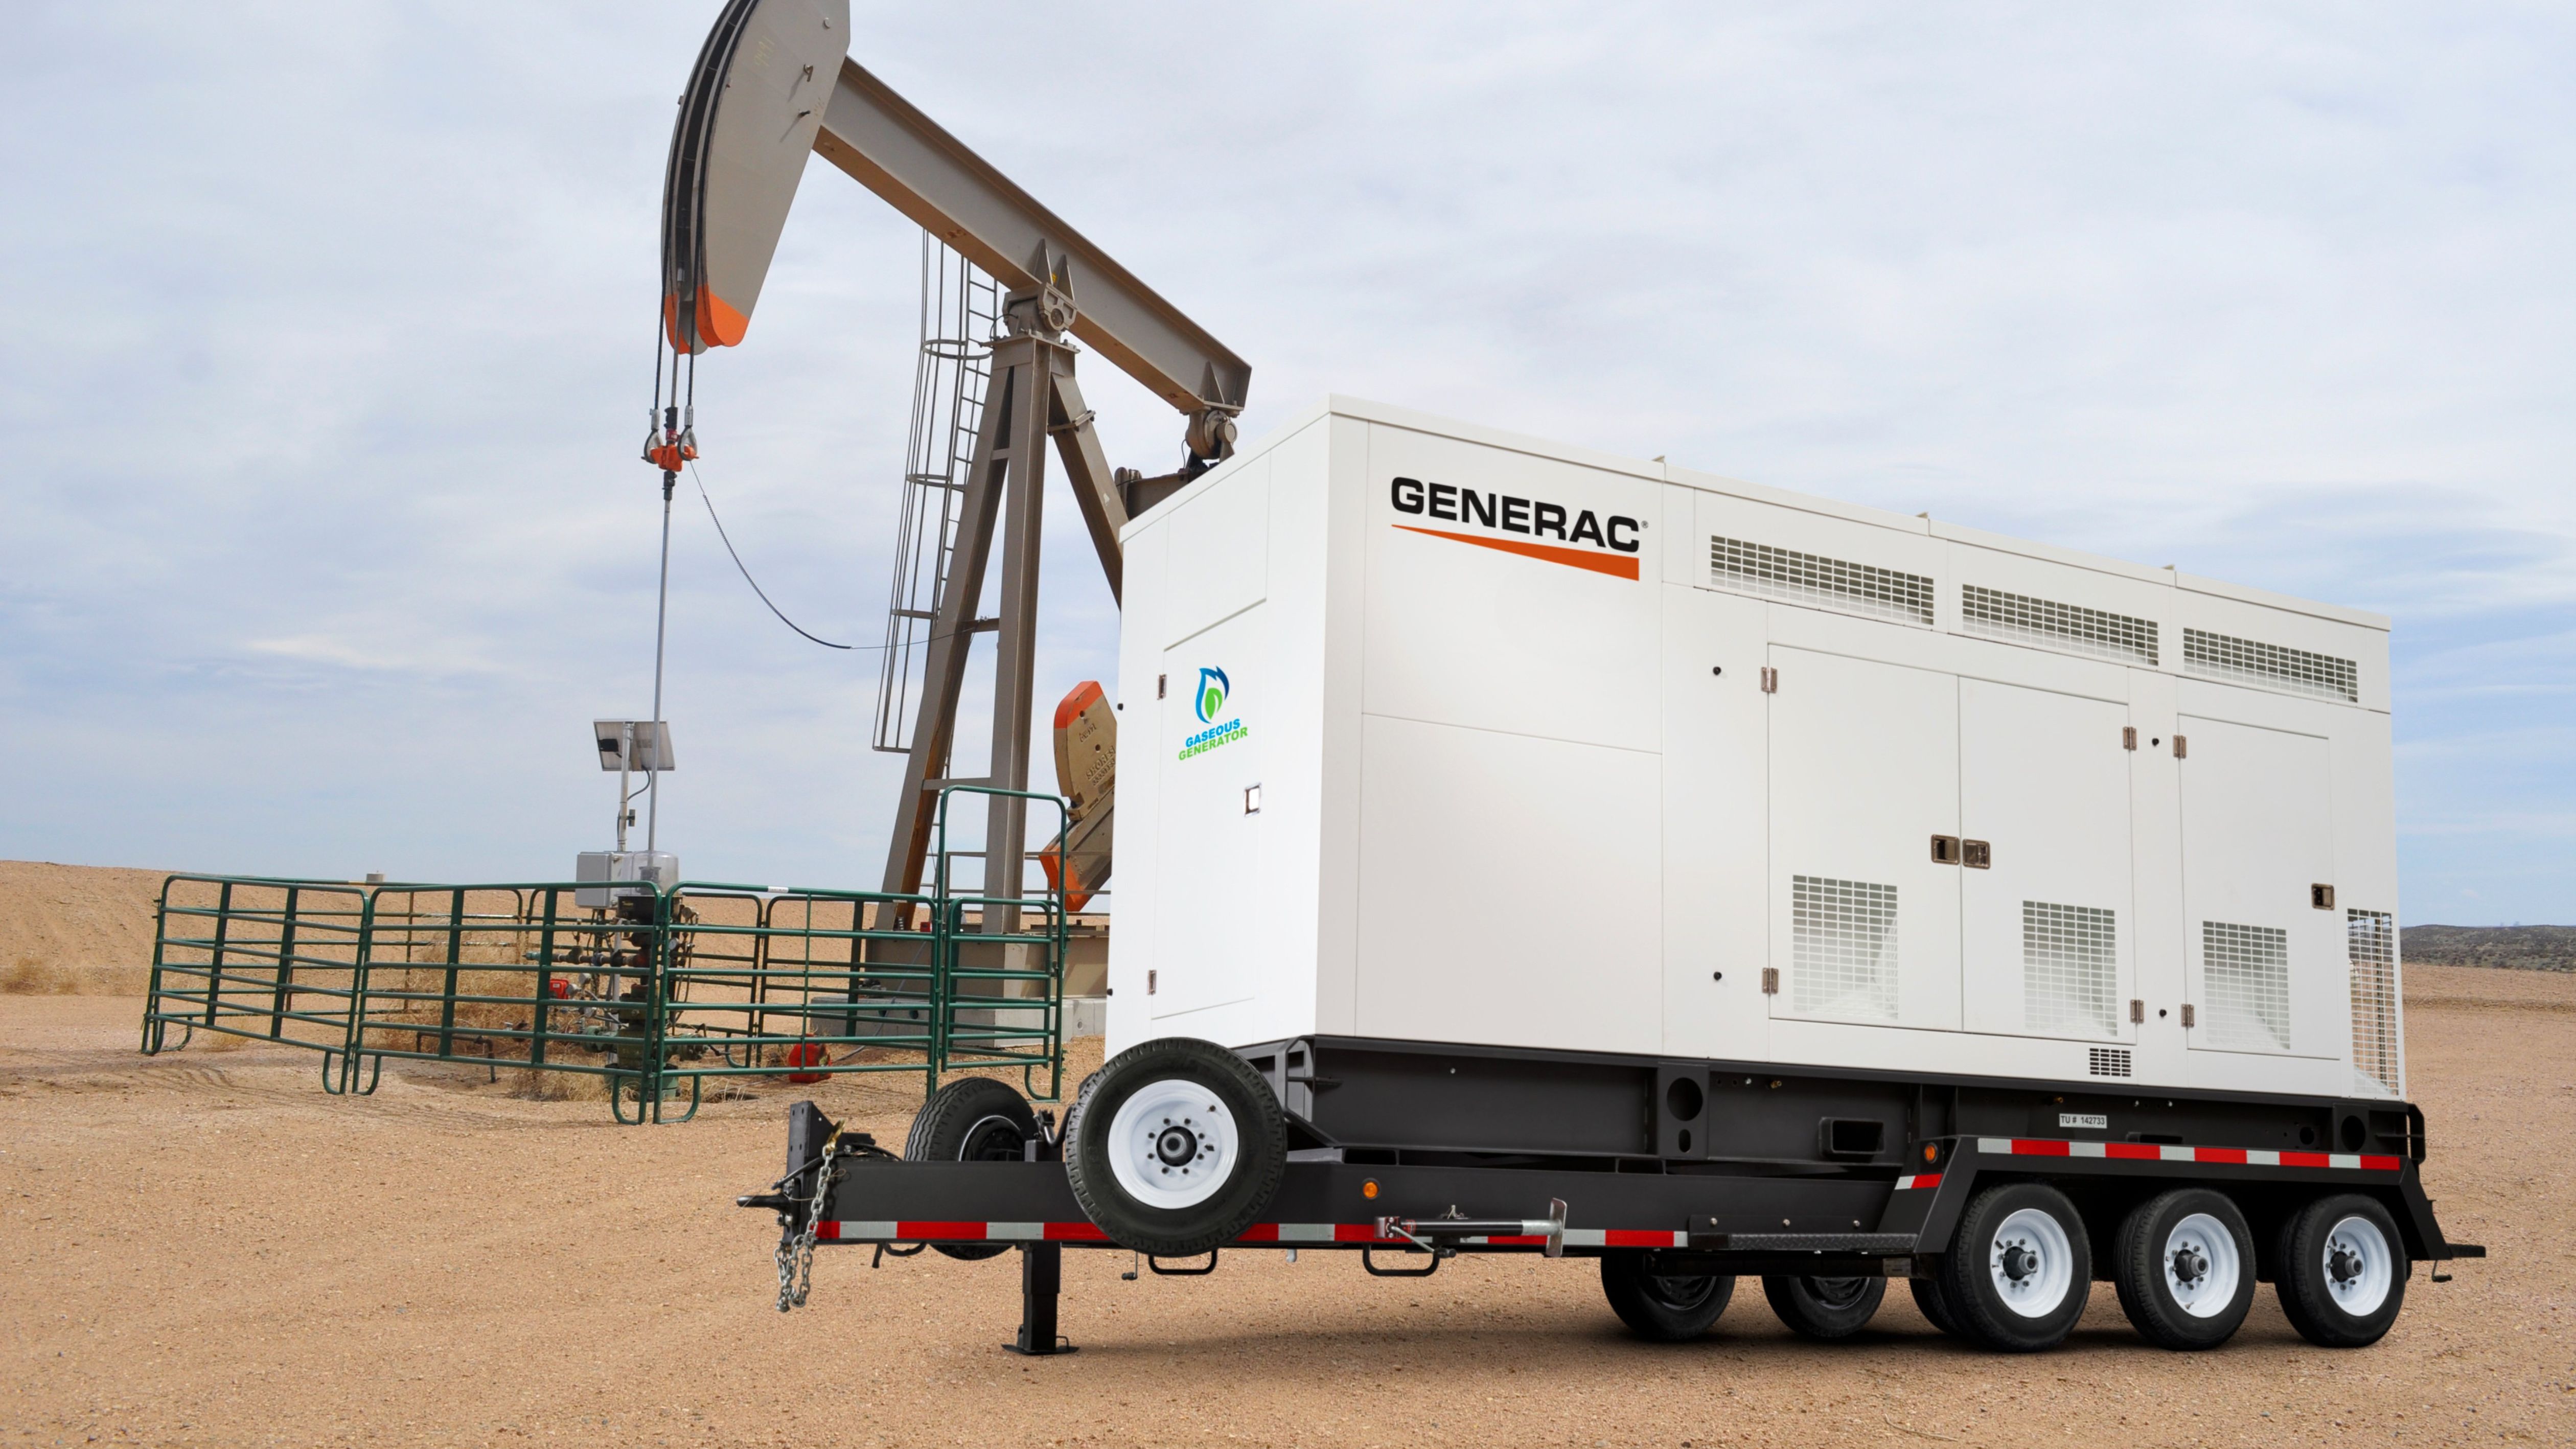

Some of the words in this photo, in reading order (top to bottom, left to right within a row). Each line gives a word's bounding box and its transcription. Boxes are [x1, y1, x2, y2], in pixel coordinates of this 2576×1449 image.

[1391, 477, 1639, 553] GENERAC
[1178, 727, 1248, 761] GENERATOR
[1185, 719, 1240, 748] GASEOUS
[2081, 1116, 2105, 1125] 142733
